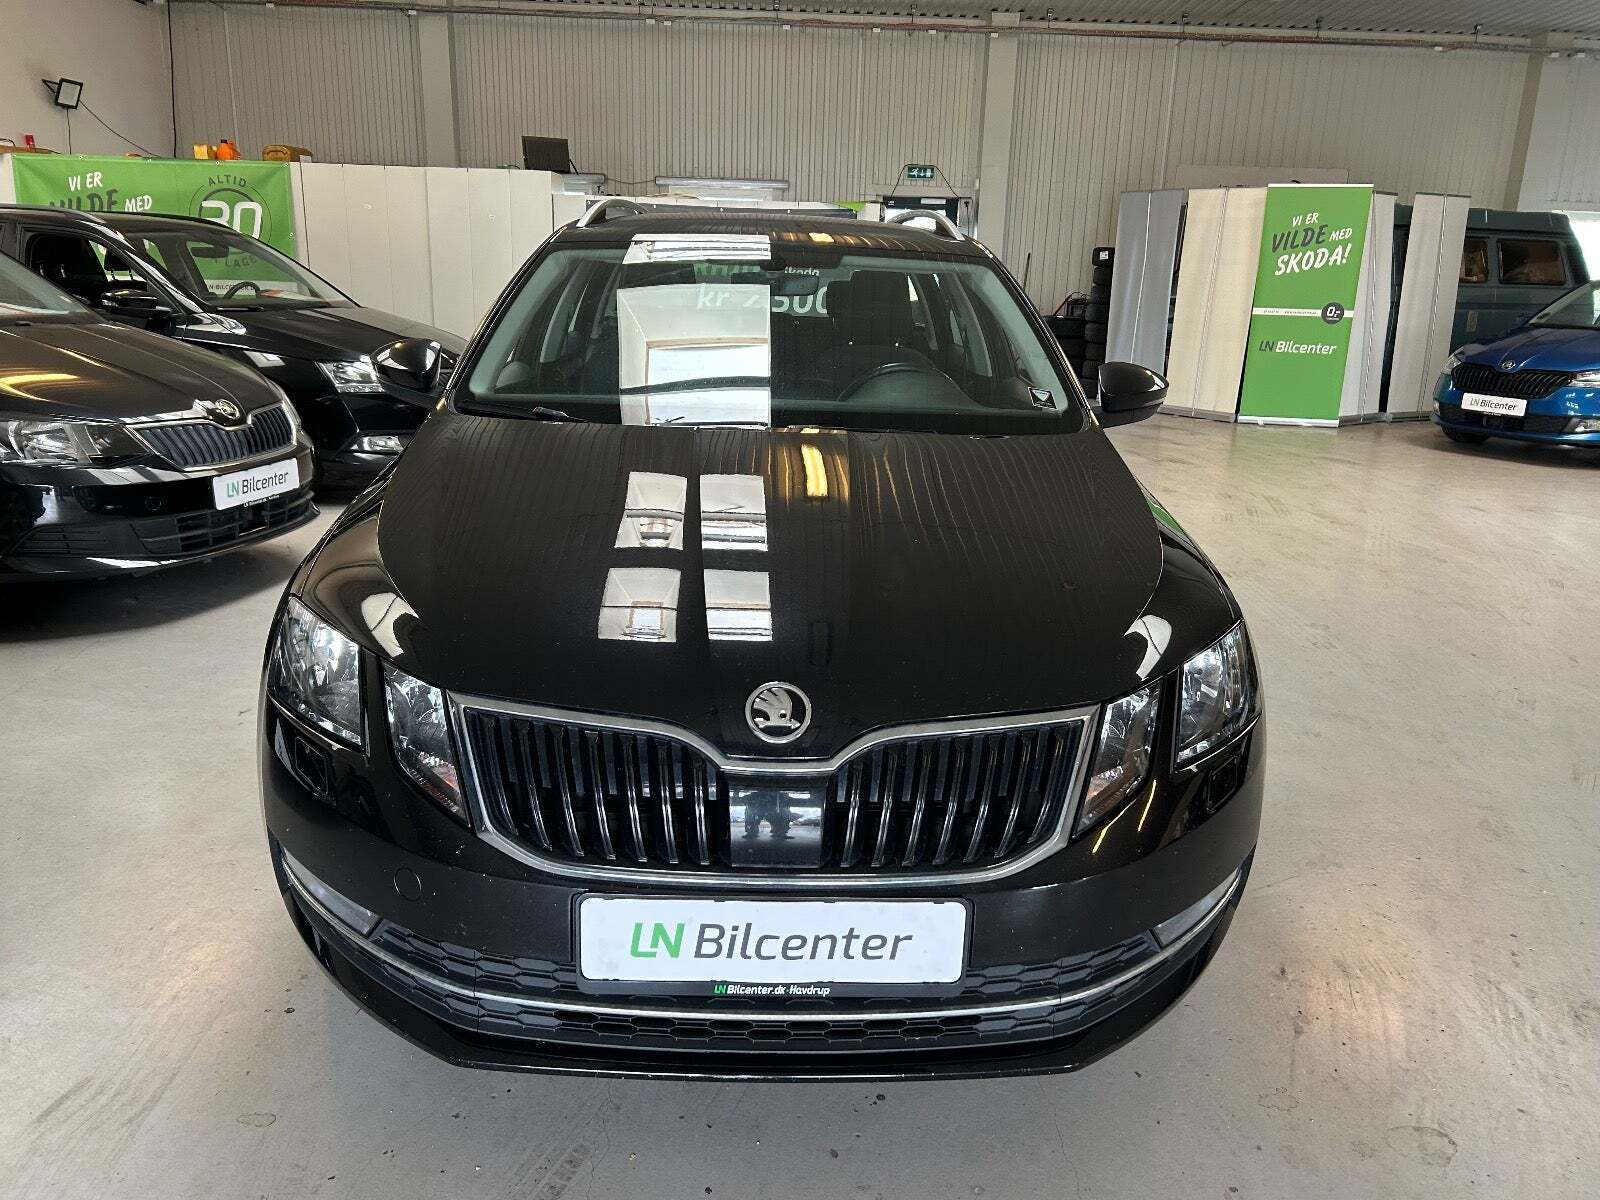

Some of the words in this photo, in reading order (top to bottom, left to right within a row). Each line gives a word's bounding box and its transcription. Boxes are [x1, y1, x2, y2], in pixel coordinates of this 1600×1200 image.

[68, 176, 81, 192] VI
[86, 171, 103, 189] ER
[208, 174, 248, 188] ALTID
[124, 195, 153, 213] MED
[1292, 215, 1302, 227] VI
[1305, 212, 1319, 225] ER
[1271, 224, 1328, 253] VILDE
[1329, 227, 1352, 241] MED
[1274, 242, 1352, 276] SKODA!
[1259, 341, 1274, 352] LN
[1275, 340, 1337, 355] Bilcenter
[1480, 399, 1517, 411] Bilcenter
[227, 480, 240, 498] LN
[242, 471, 289, 495] Bilcenter
[630, 922, 685, 958] LN
[694, 922, 913, 961] Bilcenter
[714, 985, 726, 994] LN
[789, 985, 831, 998] Havdrup
